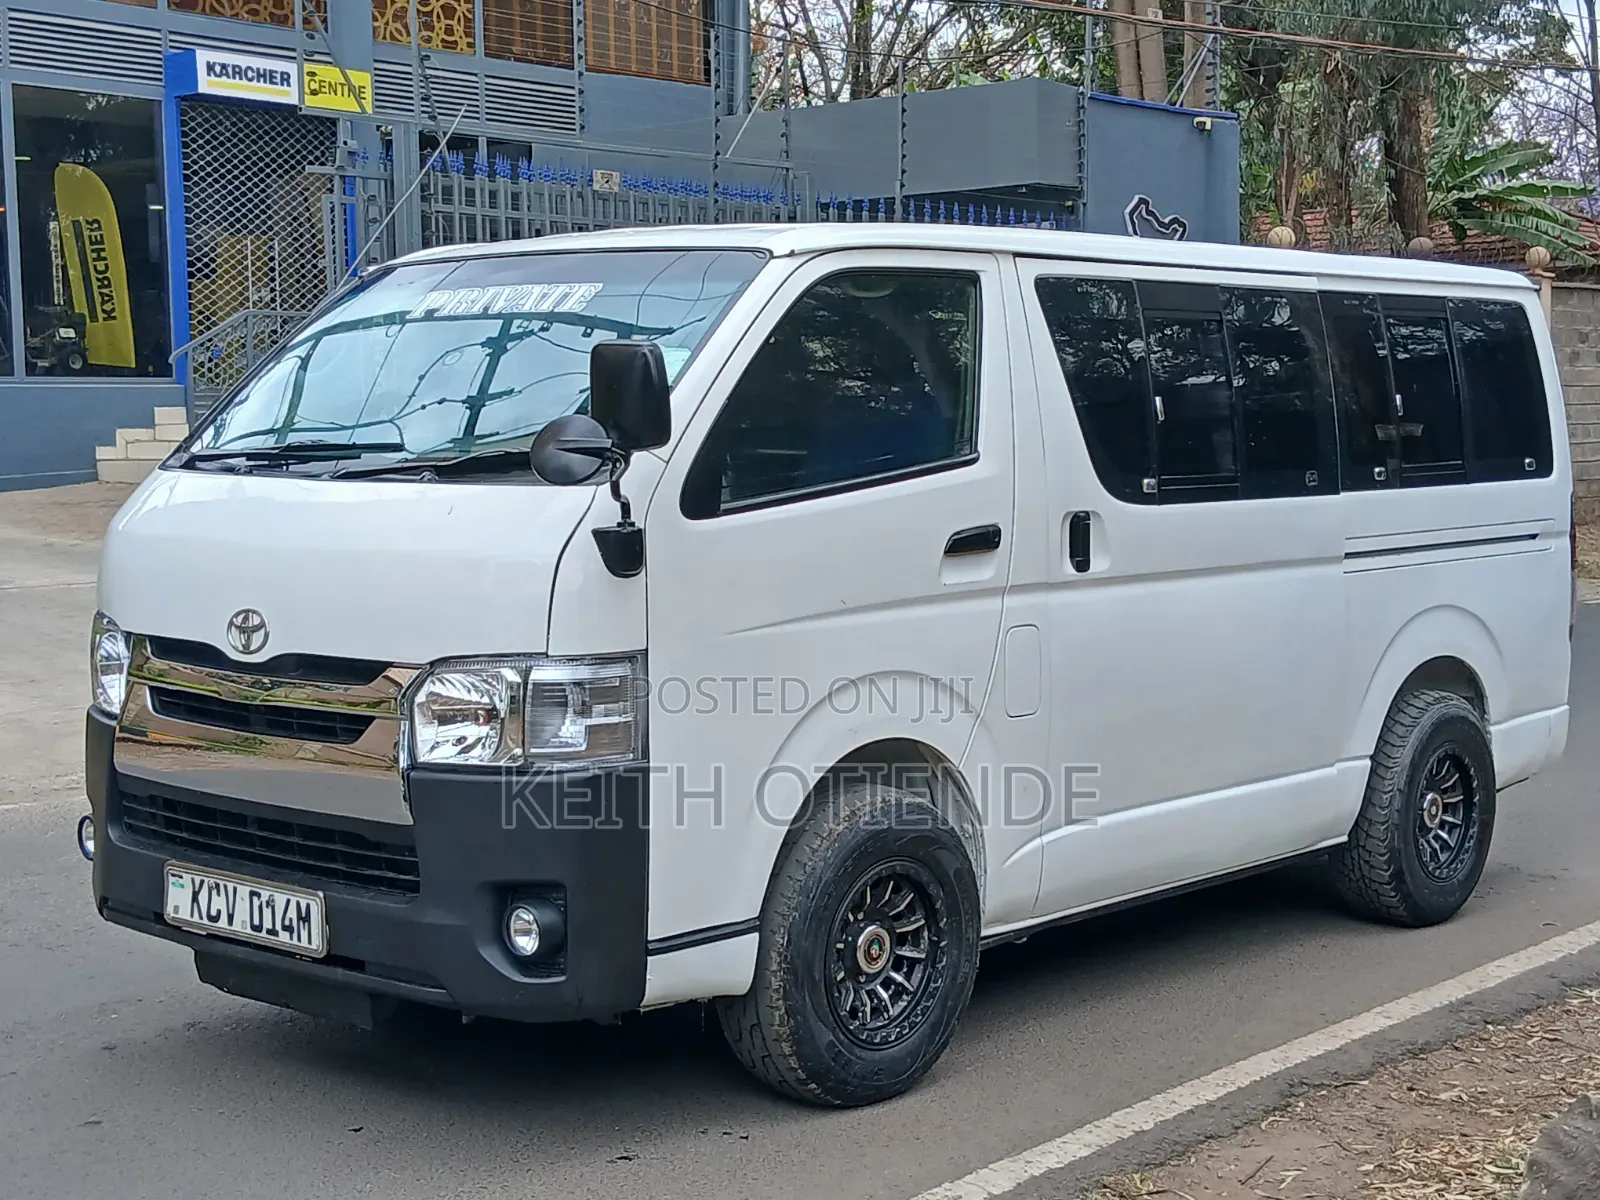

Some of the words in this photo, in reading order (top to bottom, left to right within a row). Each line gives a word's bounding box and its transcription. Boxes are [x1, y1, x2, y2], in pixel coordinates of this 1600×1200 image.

[206, 60, 291, 88] KÄRCHER
[406, 283, 603, 319] PRIVATE
[190, 876, 238, 927] KCV
[249, 889, 312, 945] 014M
